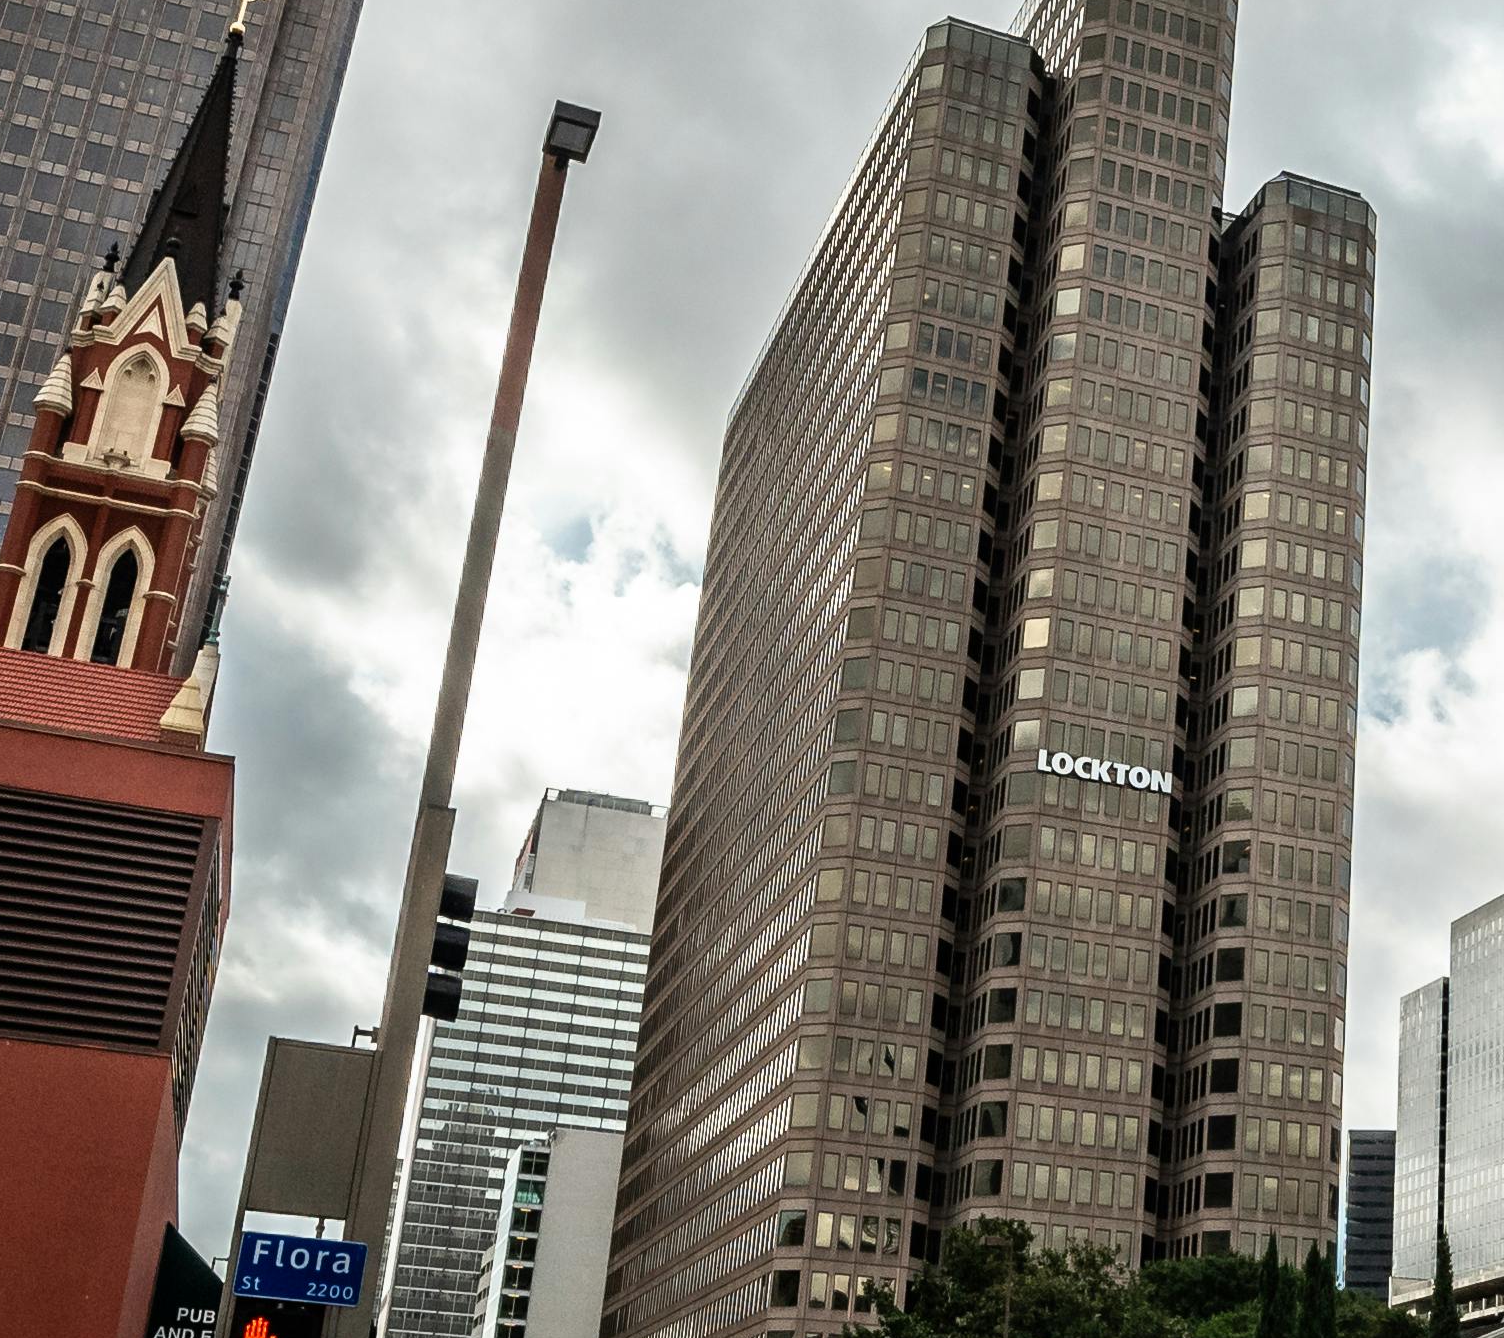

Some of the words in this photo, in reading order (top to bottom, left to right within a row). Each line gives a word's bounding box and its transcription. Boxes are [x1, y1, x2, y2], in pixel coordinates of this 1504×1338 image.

[1037, 748, 1173, 794] LOCKTON
[252, 1239, 352, 1274] Flora
[241, 1276, 261, 1291] St
[306, 1282, 354, 1300] 2200
